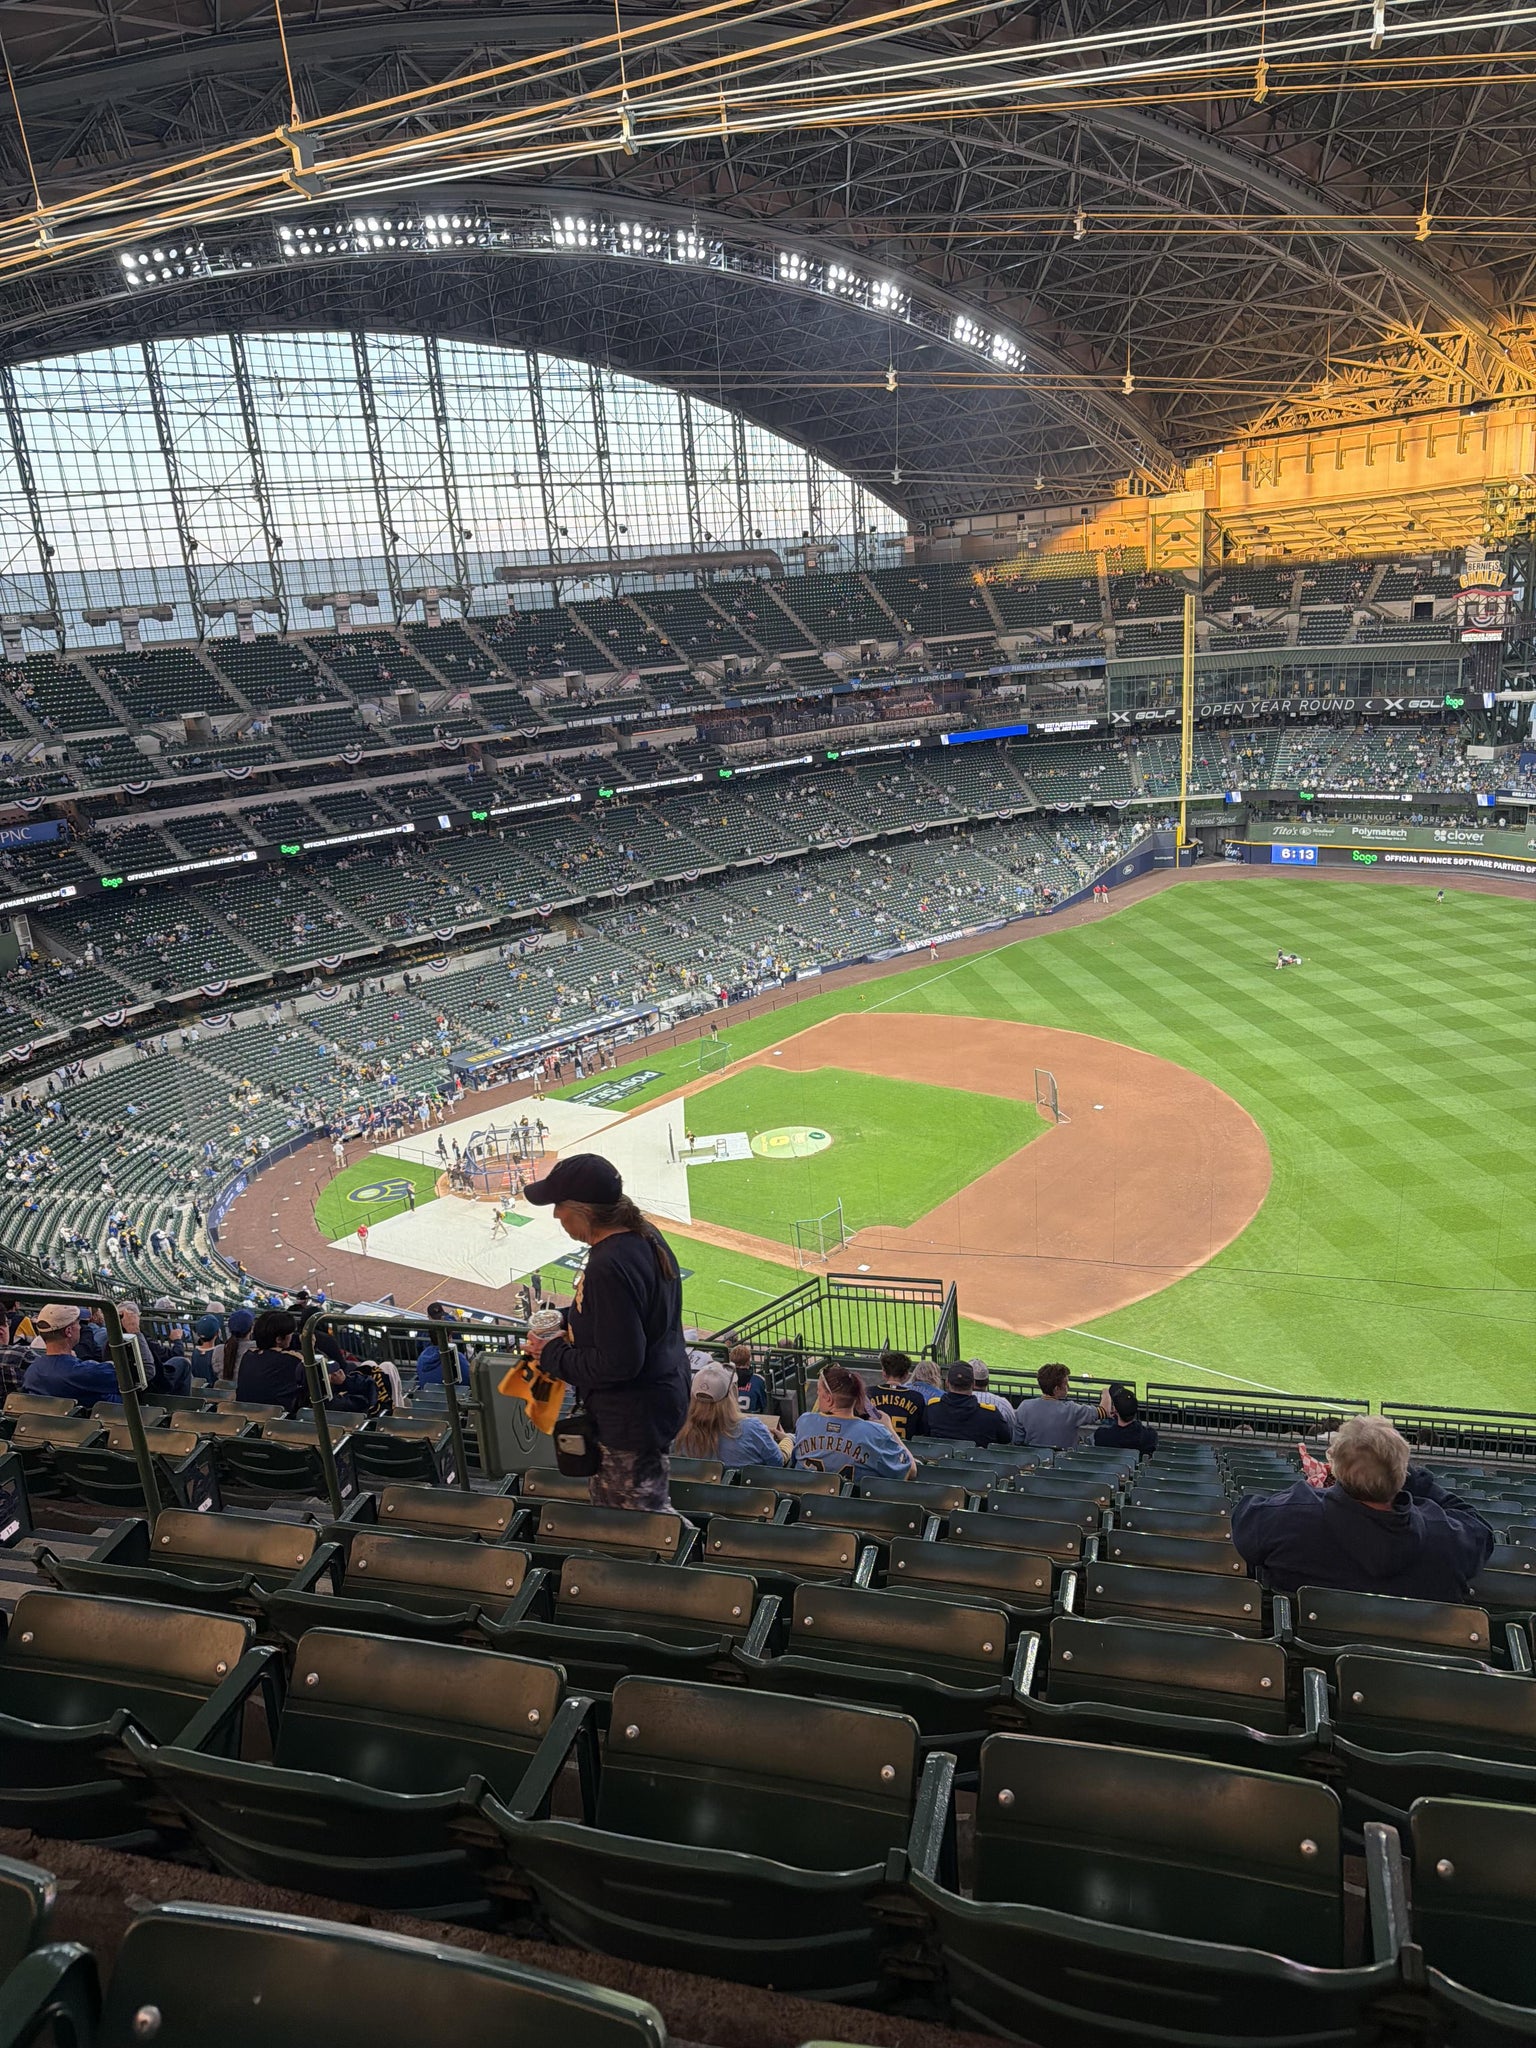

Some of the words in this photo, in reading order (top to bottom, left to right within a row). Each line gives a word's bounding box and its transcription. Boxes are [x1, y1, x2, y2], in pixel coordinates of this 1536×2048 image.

[1494, 530, 1505, 538] GET
[1507, 529, 1516, 537] UP
[1468, 560, 1500, 571] BERNIE'S
[1460, 570, 1507, 589] CHALET
[859, 681, 895, 689] Northwestern
[896, 677, 913, 685] Mutual
[1135, 709, 1176, 720] GOLF
[1200, 703, 1244, 717] OPEN
[1250, 700, 1292, 713] YEAR
[1299, 699, 1355, 711] ROUND
[1215, 815, 1236, 826] Yard
[0, 827, 32, 843] PNC
[1272, 826, 1298, 836] Tito's
[1351, 827, 1407, 838] Polymatech
[1447, 829, 1485, 841] clover
[280, 845, 299, 854] Sage
[326, 836, 347, 845] FINANCE
[348, 832, 373, 841] SOFTWARE
[374, 828, 395, 836] PARTNER
[1281, 848, 1314, 860] 6:13
[1352, 850, 1378, 865] Sage
[1385, 854, 1418, 864] OFFICIAL
[1419, 856, 1452, 865] FINANCE
[1453, 858, 1493, 868] SOFTWARE
[1493, 861, 1526, 873] PARTNER
[1526, 866, 1536, 874] OF
[101, 868, 122, 887] Sage
[127, 872, 153, 881] OFFICIAL
[153, 867, 178, 876] FINANCE
[178, 861, 209, 872] SOFTWARE
[209, 857, 234, 866] PARTNER
[500, 1014, 614, 1052] POSTSEASON
[581, 1071, 660, 1106] POSTSEA
[869, 1394, 918, 1415] ALMISANO
[798, 1435, 870, 1465] CONTRERAS
